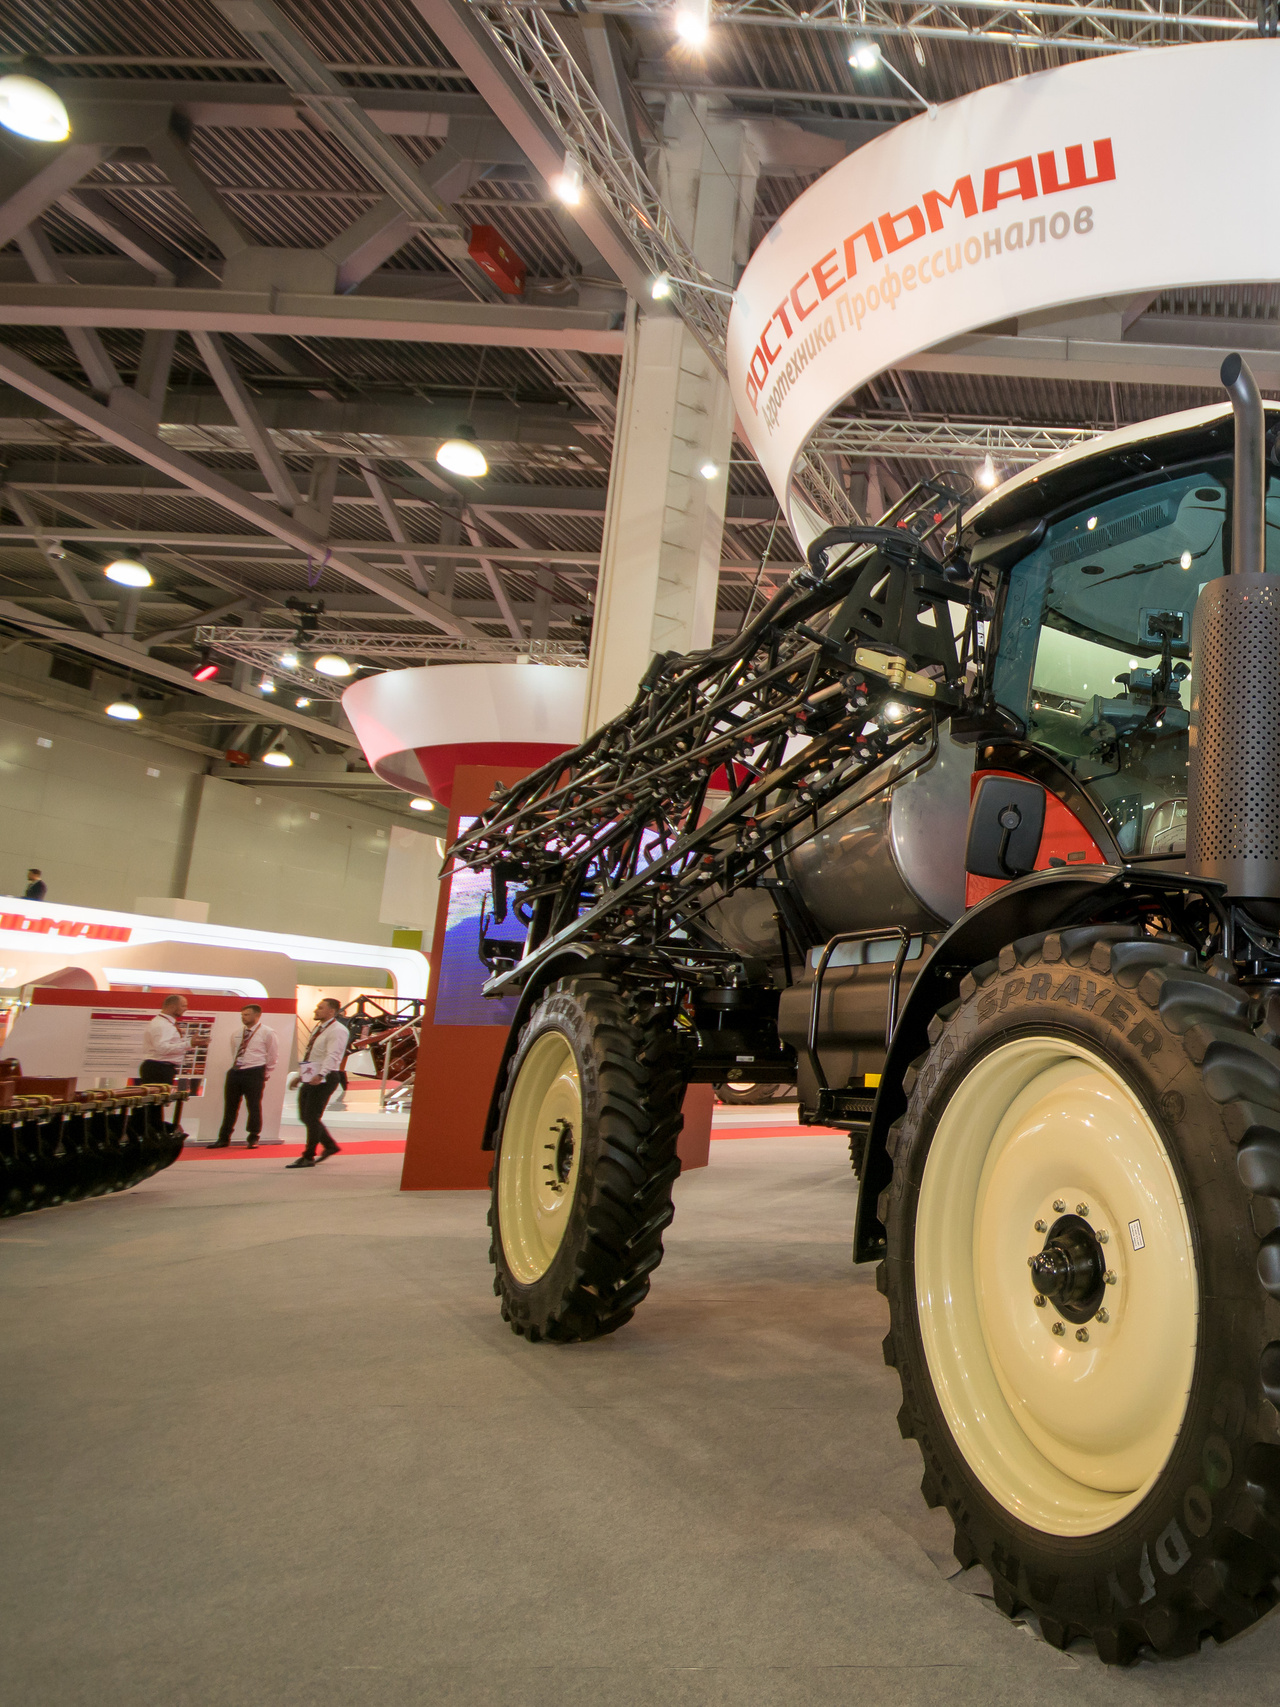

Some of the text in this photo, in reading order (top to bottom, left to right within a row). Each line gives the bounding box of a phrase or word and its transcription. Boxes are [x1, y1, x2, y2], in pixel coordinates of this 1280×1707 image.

[745, 136, 1117, 416] РОСТСЕЛЬМАШ
[761, 204, 1095, 436] Агротехника Профессионалов
[545, 996, 583, 1034] ULTRA
[976, 971, 1164, 1061] SPRAYER
